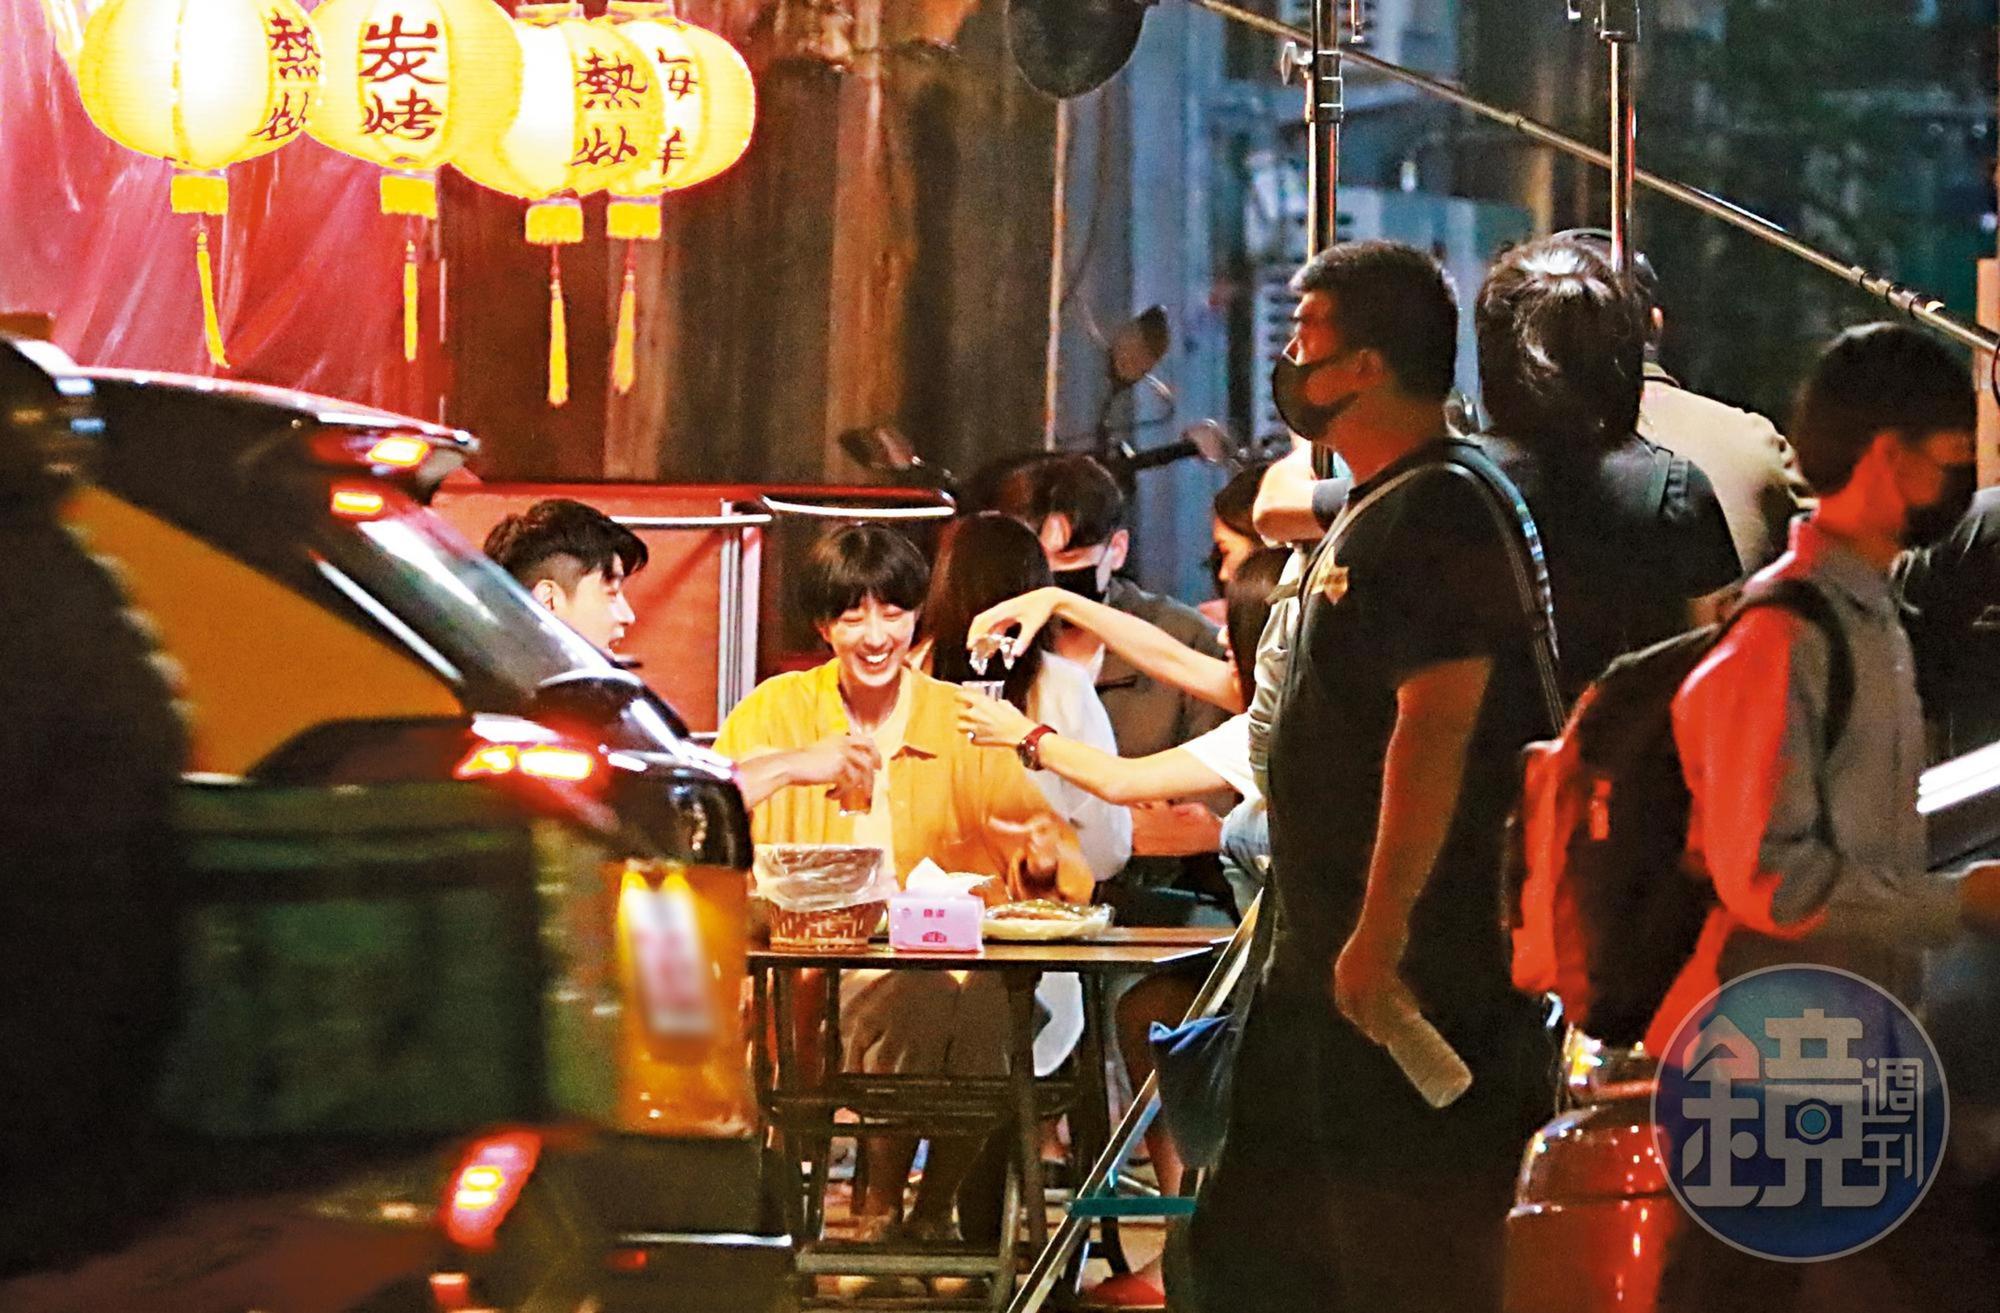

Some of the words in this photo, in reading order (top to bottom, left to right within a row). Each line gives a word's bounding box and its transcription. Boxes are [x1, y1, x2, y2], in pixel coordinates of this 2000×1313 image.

[251, 9, 321, 141] 熱炒
[358, 14, 446, 140] 炭烤
[570, 50, 648, 166] 熱炒
